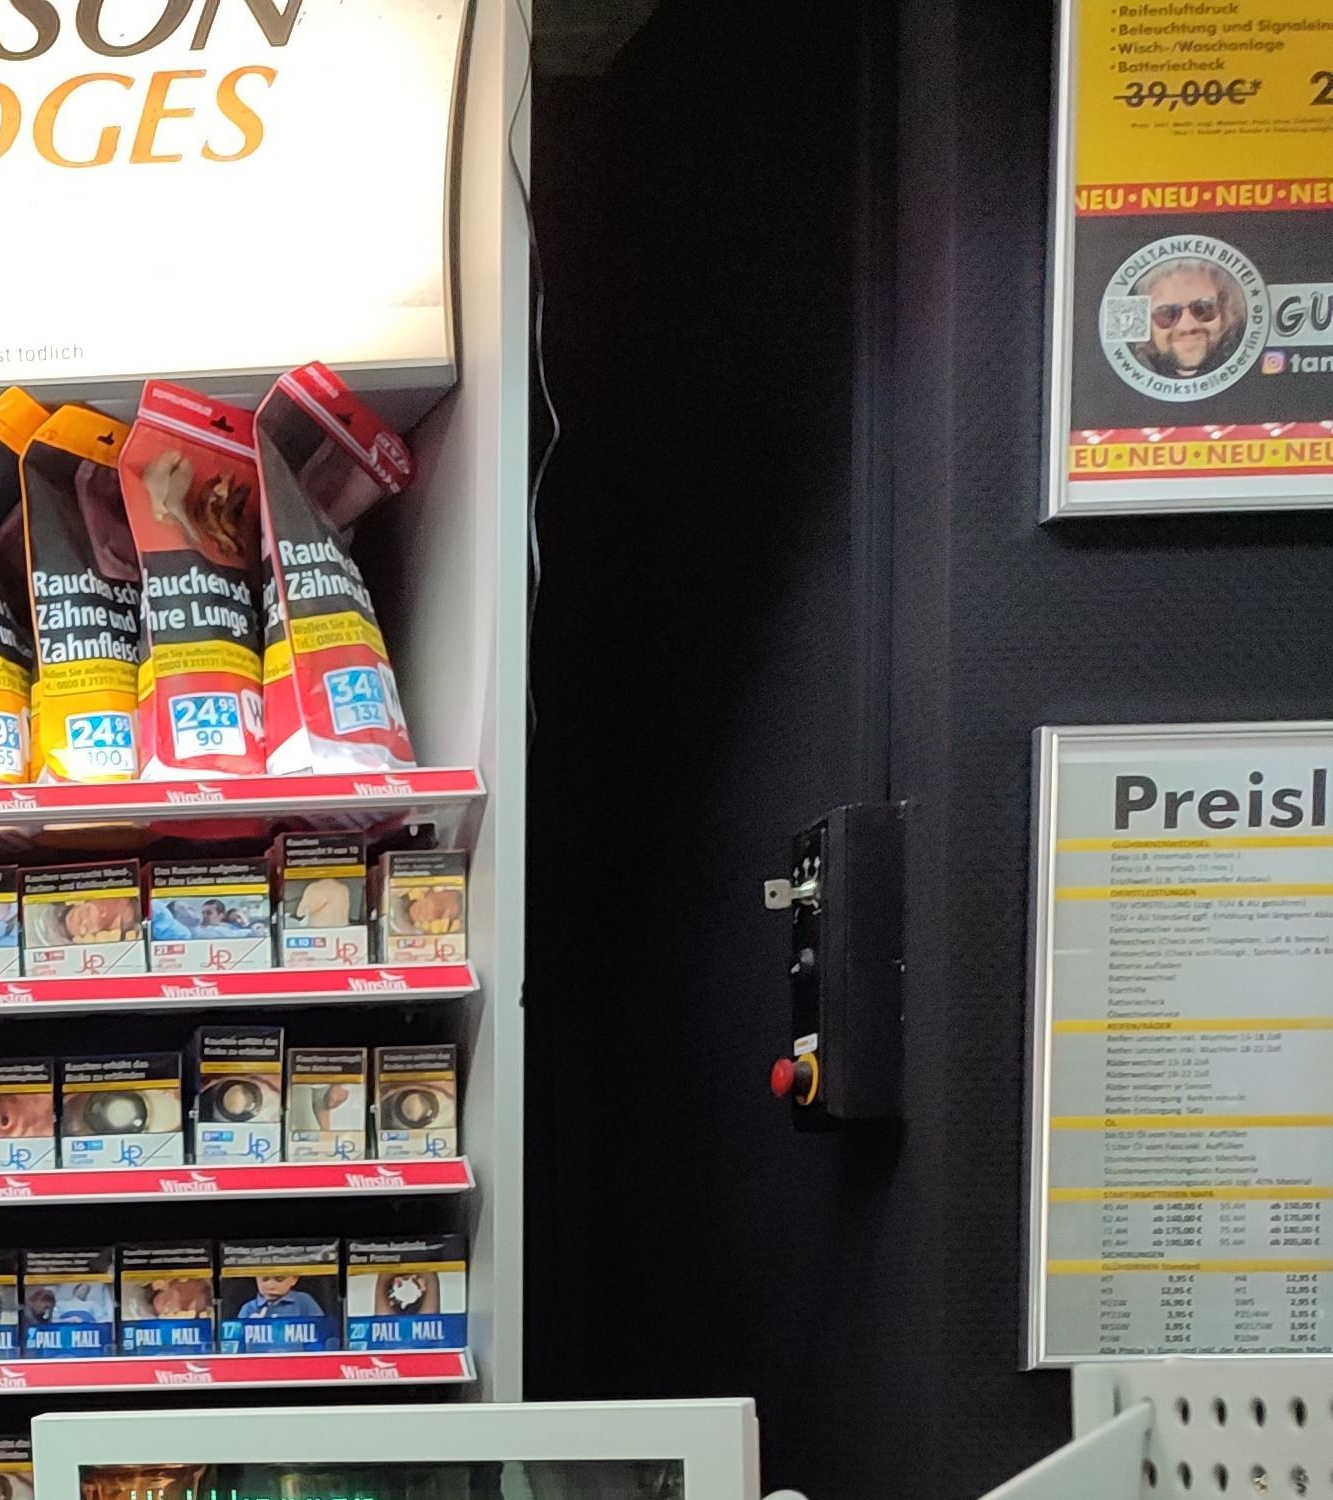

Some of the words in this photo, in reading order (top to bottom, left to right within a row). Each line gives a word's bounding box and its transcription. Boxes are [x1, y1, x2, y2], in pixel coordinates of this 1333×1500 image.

[1120, 21, 1217, 36] Beleuchtung
[1223, 21, 1252, 32] und
[1141, 188, 1197, 208] NEU
[1216, 185, 1274, 205] NEU
[1129, 445, 1188, 467] NEU
[1207, 442, 1266, 464] NEU
[35, 605, 109, 631] Zähne
[191, 606, 249, 638] Lunge
[245, 1325, 274, 1344] PALL
[284, 1324, 318, 1342] MALL
[372, 1324, 402, 1343] PALL
[412, 1322, 445, 1340] MALL
